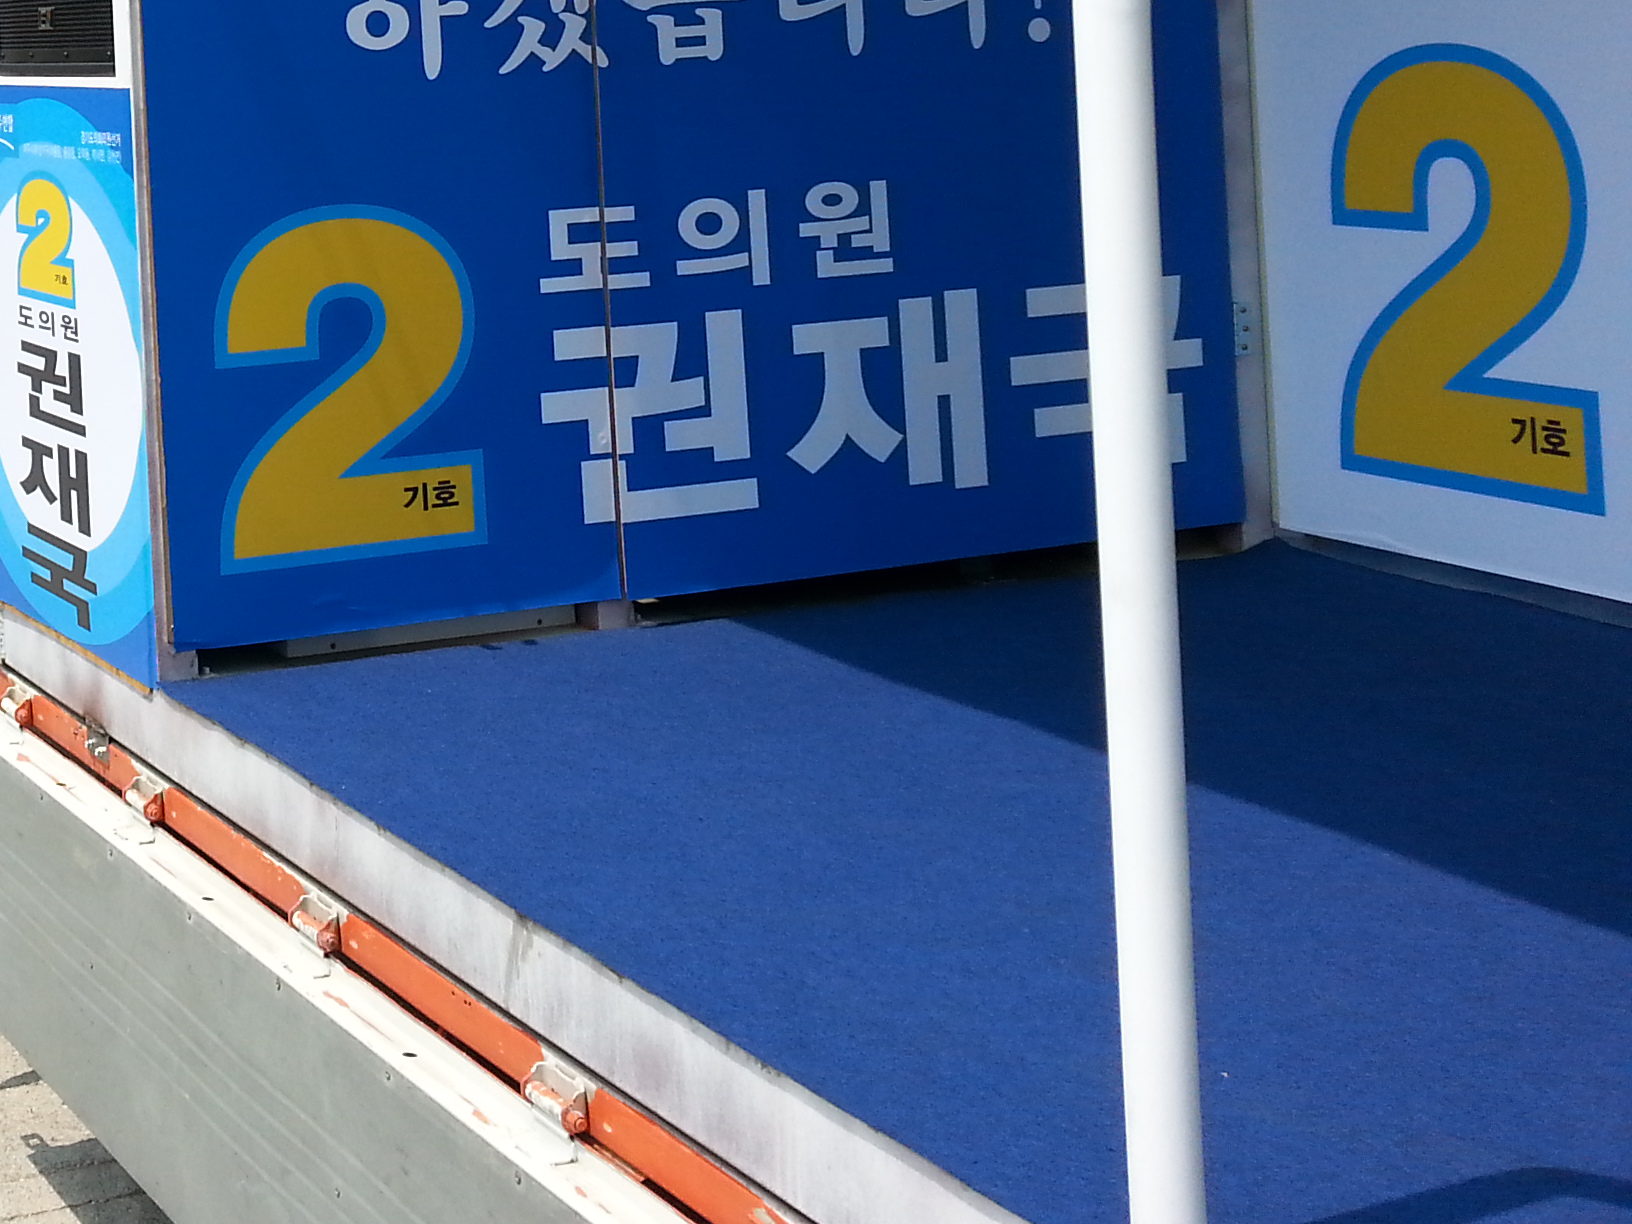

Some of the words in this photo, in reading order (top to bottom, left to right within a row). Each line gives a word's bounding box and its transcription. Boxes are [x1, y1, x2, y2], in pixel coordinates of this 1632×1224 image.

[17, 169, 77, 309] 2
[539, 179, 895, 294] 도의원
[1331, 42, 1607, 517] 2
[17, 303, 80, 344] 도의원
[213, 203, 488, 575] 2
[1511, 416, 1571, 458] 기호
[16, 338, 98, 634] 권재국
[402, 480, 460, 512] 기호
